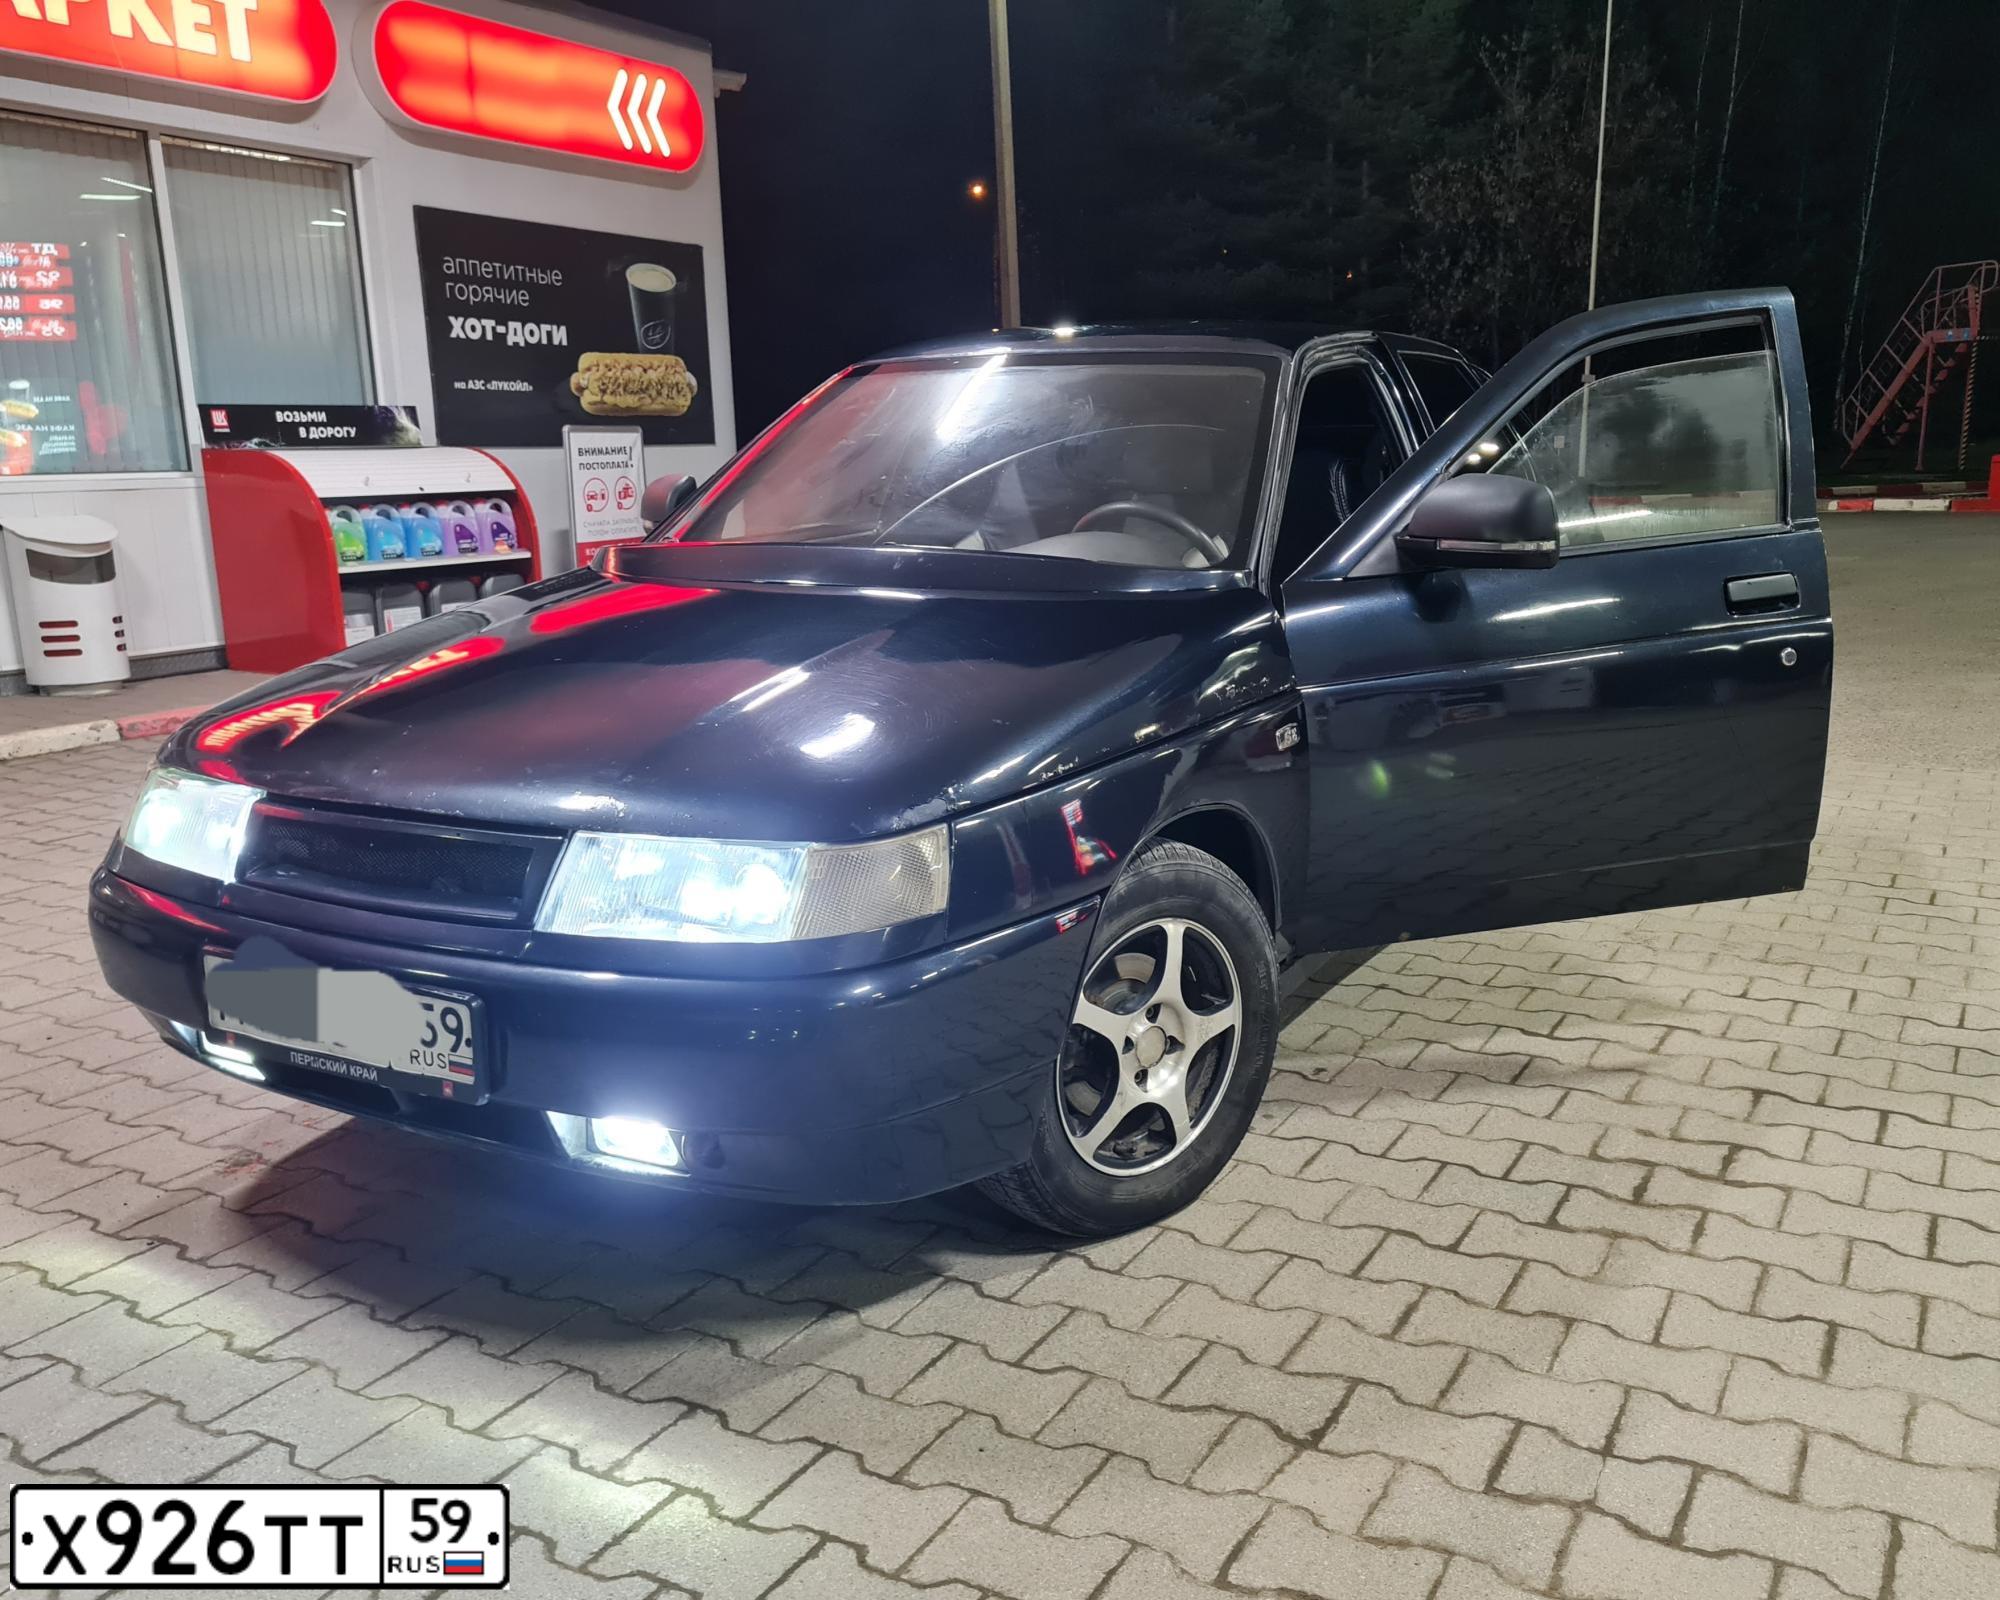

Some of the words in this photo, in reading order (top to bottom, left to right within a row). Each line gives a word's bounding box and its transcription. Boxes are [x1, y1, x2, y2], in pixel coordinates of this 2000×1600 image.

[443, 256, 562, 286] аппетитные
[445, 282, 529, 306] горячие
[454, 381, 467, 390] на
[467, 380, 485, 390] АЗС
[486, 380, 533, 392] «ЛУКОЙЛ»
[275, 410, 328, 423] ВОЗЬМИ
[299, 427, 308, 439] В
[308, 426, 357, 440] ДОРОГУ
[409, 1048, 448, 1070] RUS
[349, 1064, 379, 1082] КРАЙ
